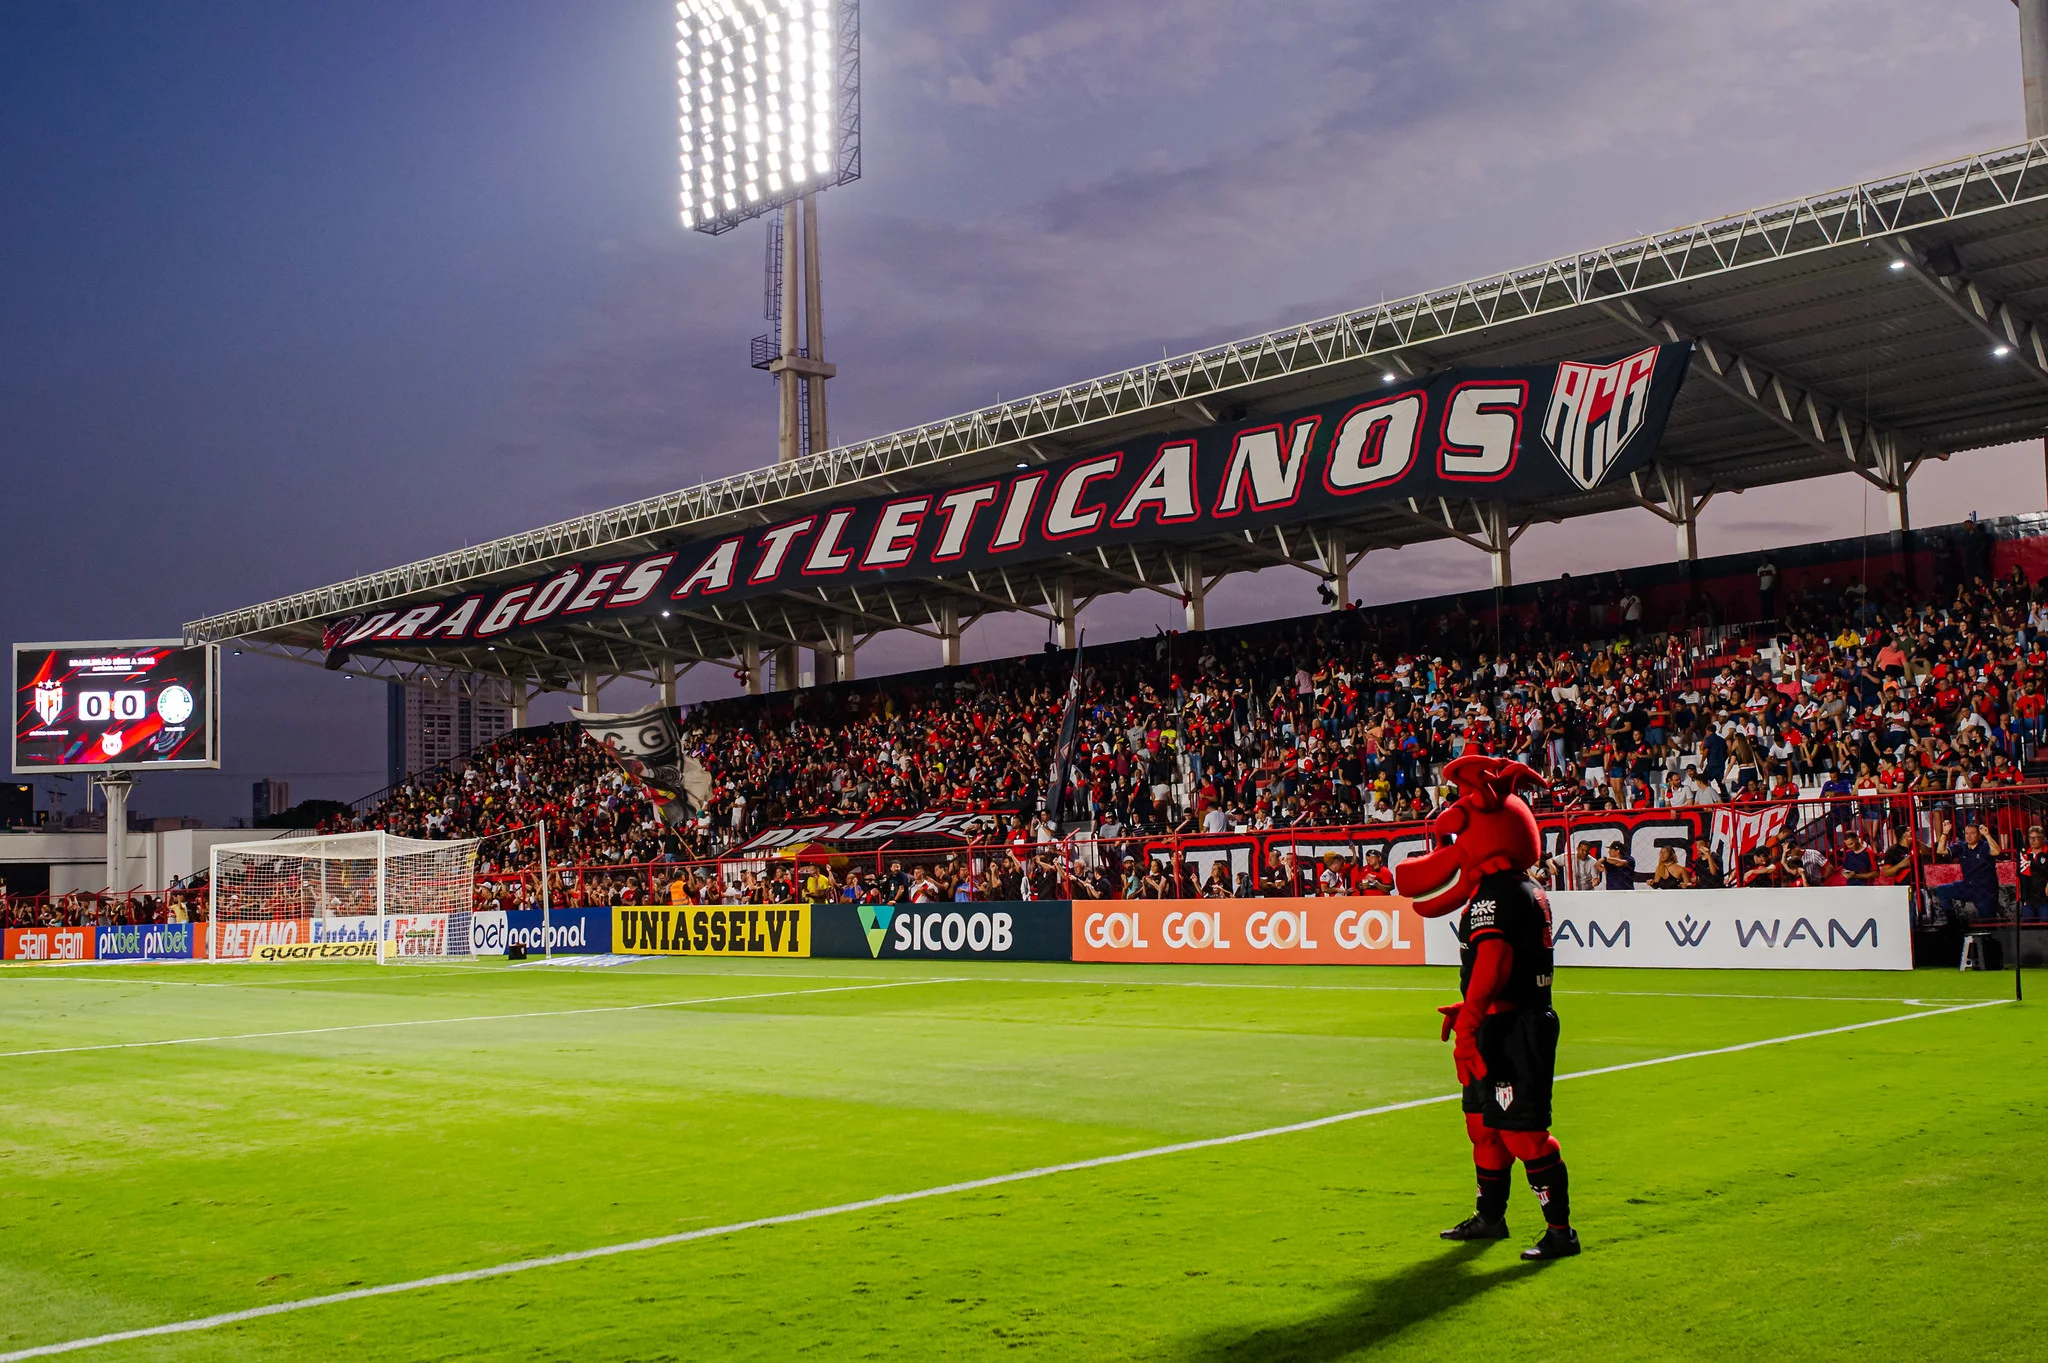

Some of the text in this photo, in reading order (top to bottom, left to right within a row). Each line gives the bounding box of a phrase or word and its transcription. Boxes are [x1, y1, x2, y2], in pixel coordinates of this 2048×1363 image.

[338, 382, 1527, 647] DRAGÕES ATLETICANOS
[86, 695, 102, 717] 0
[121, 695, 137, 717] 0
[99, 924, 188, 960] pixbet pixbet
[221, 921, 298, 957] BETANO
[621, 910, 800, 953] UNIASSELVI
[894, 912, 1014, 952] SICOOB
[1084, 910, 1411, 950] GOL GOL GOL GOL
[1735, 917, 1878, 949] WAM
